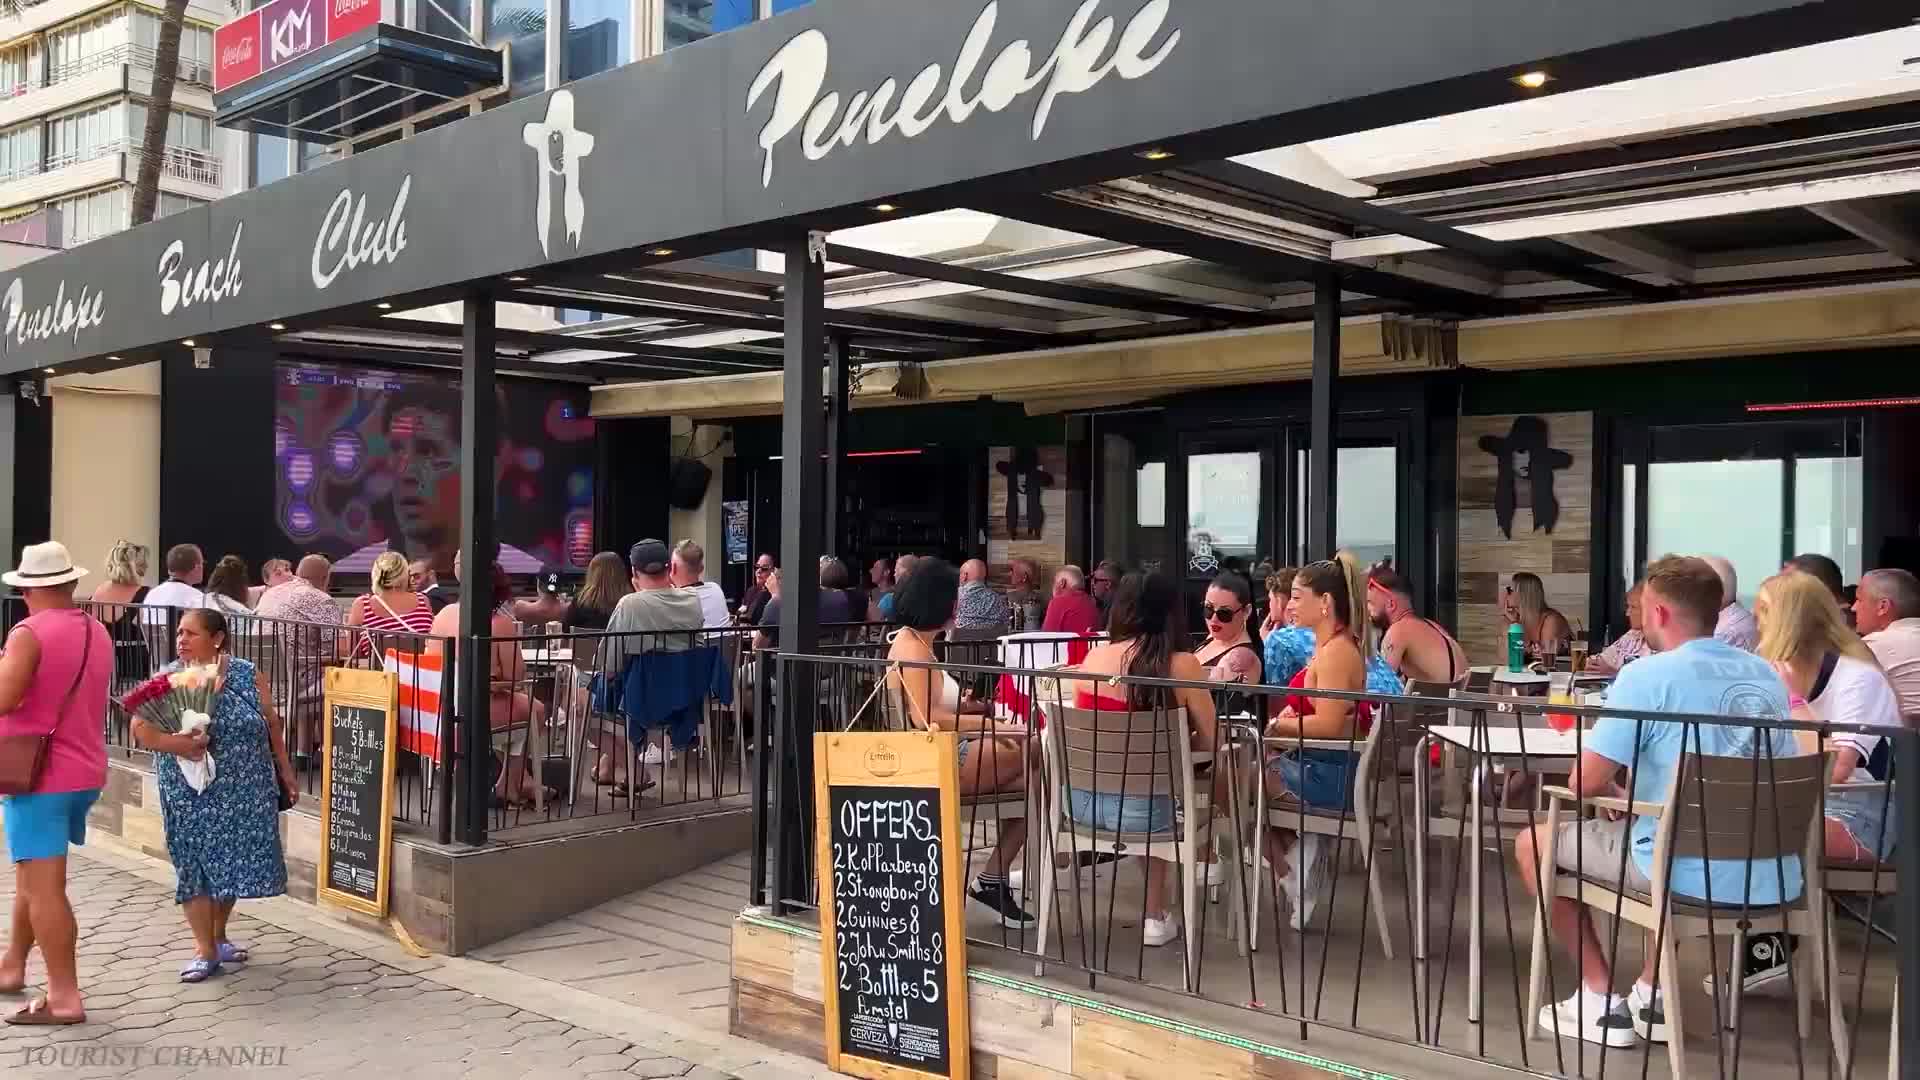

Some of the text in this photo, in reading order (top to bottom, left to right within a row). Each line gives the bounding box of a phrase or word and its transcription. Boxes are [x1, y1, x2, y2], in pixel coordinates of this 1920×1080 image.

[746, 0, 1181, 188] Penelope
[2, 174, 411, 353] Penelope Beach Club
[350, 730, 358, 746] 5
[840, 799, 941, 842] OFFERS
[833, 842, 846, 870] 2
[927, 843, 938, 876] 8
[834, 871, 847, 898] 2
[928, 875, 939, 906] 8
[836, 900, 848, 928] 2
[909, 904, 920, 935] 8
[837, 931, 849, 959] 2
[887, 933, 931, 962] Smiths
[931, 931, 943, 965] 8
[839, 960, 939, 1004] 2 Bottles 5
[858, 993, 908, 1020] Amstel
[850, 1026, 889, 1045] CERVEZA
